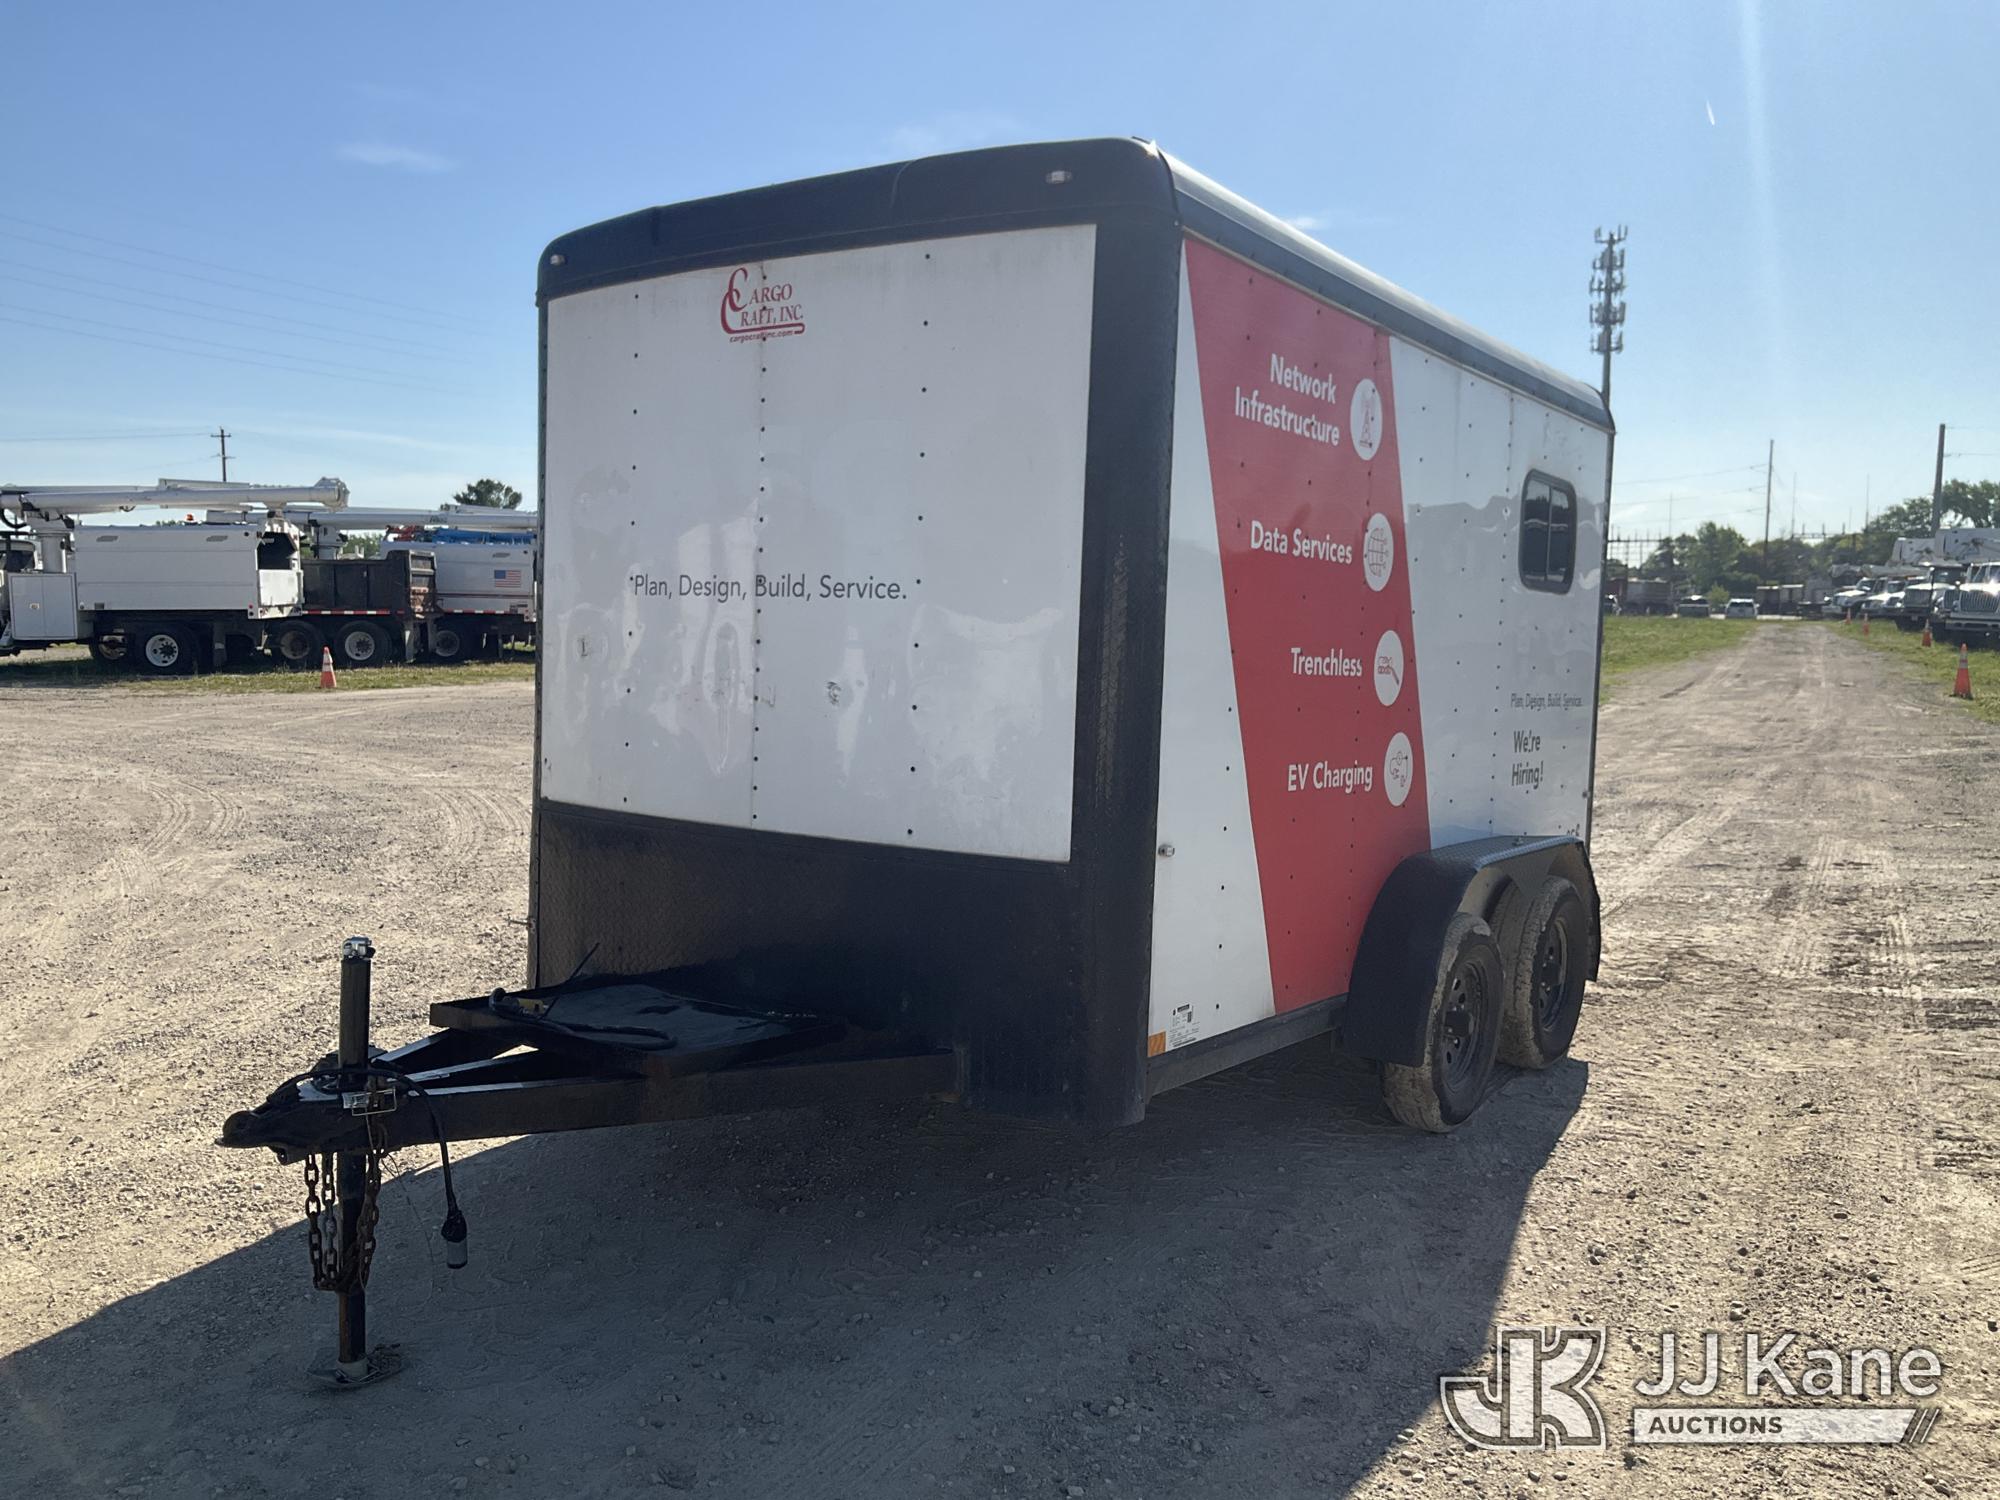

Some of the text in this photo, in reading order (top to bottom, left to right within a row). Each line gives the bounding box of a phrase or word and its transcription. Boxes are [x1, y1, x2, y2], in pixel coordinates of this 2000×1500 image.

[779, 304, 804, 322] INC.
[1270, 353, 1337, 404] Network
[1235, 386, 1340, 446] Infrastructure
[1250, 520, 1353, 564] Data Services
[633, 573, 907, 603] Plan, Design, Build, Service.
[1291, 647, 1363, 677] Trenchless
[1513, 730, 1541, 753] We're
[1288, 760, 1373, 794] EV Charging
[1511, 760, 1544, 789] Hiring!
